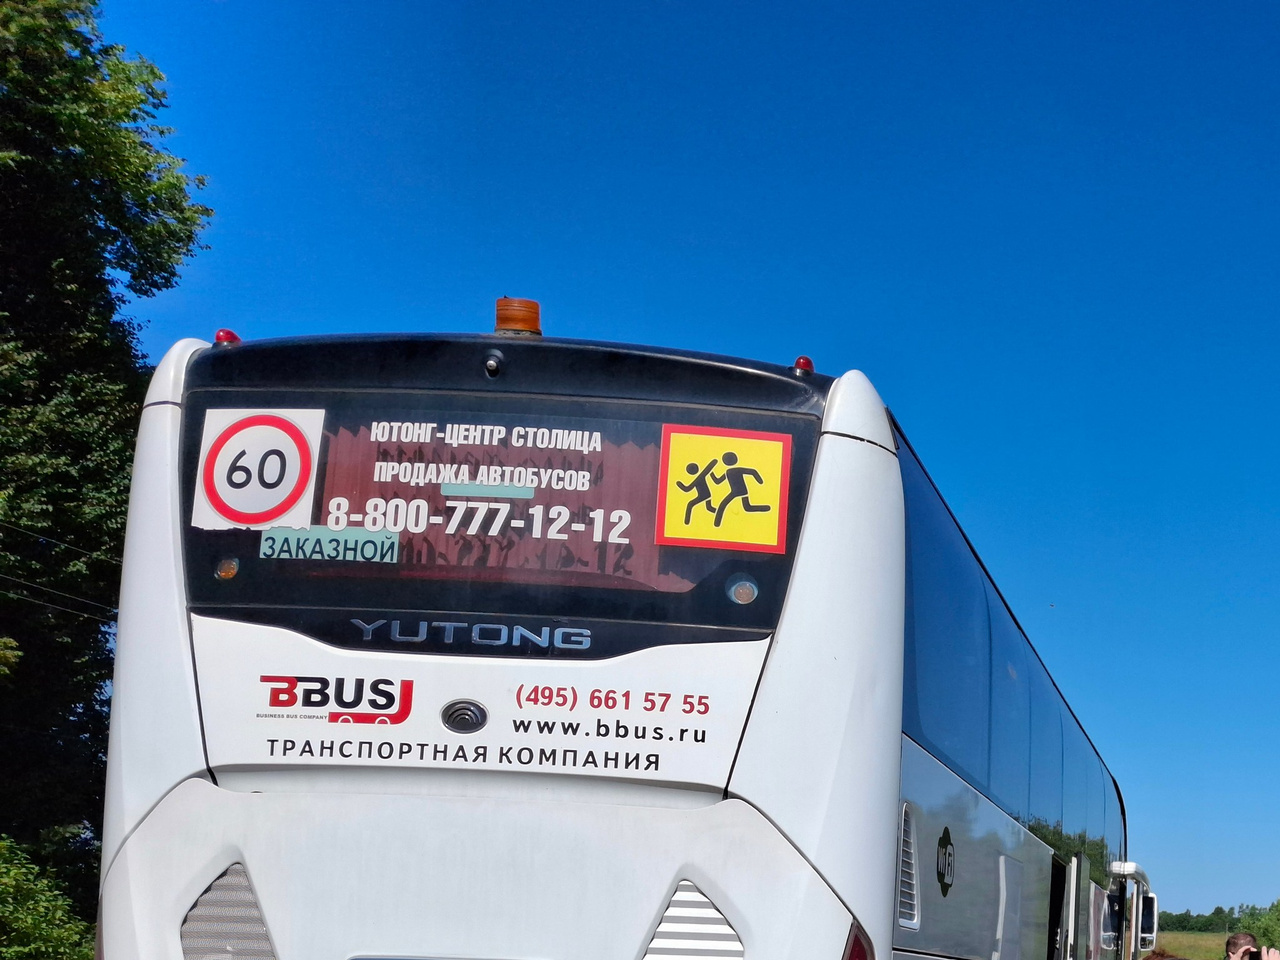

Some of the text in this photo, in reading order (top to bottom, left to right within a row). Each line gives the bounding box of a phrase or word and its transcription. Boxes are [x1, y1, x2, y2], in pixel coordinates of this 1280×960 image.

[370, 421, 602, 454] ЮТОНГ-ЦЕНТР СТОЛИЦА
[225, 448, 288, 491] 60
[373, 461, 591, 491] ПРОДАЖА АВТОБУСОВ
[326, 497, 632, 545] 8-800-777-12-12
[262, 535, 396, 562] ЗАКАЗНОЙ
[350, 618, 592, 650] YUTONG
[515, 684, 710, 715] (495) 661 57 55
[512, 718, 706, 743] www.bbus.ru
[266, 738, 661, 772] ТРАНСПОРТНАЯ КОМПАНИЯ
